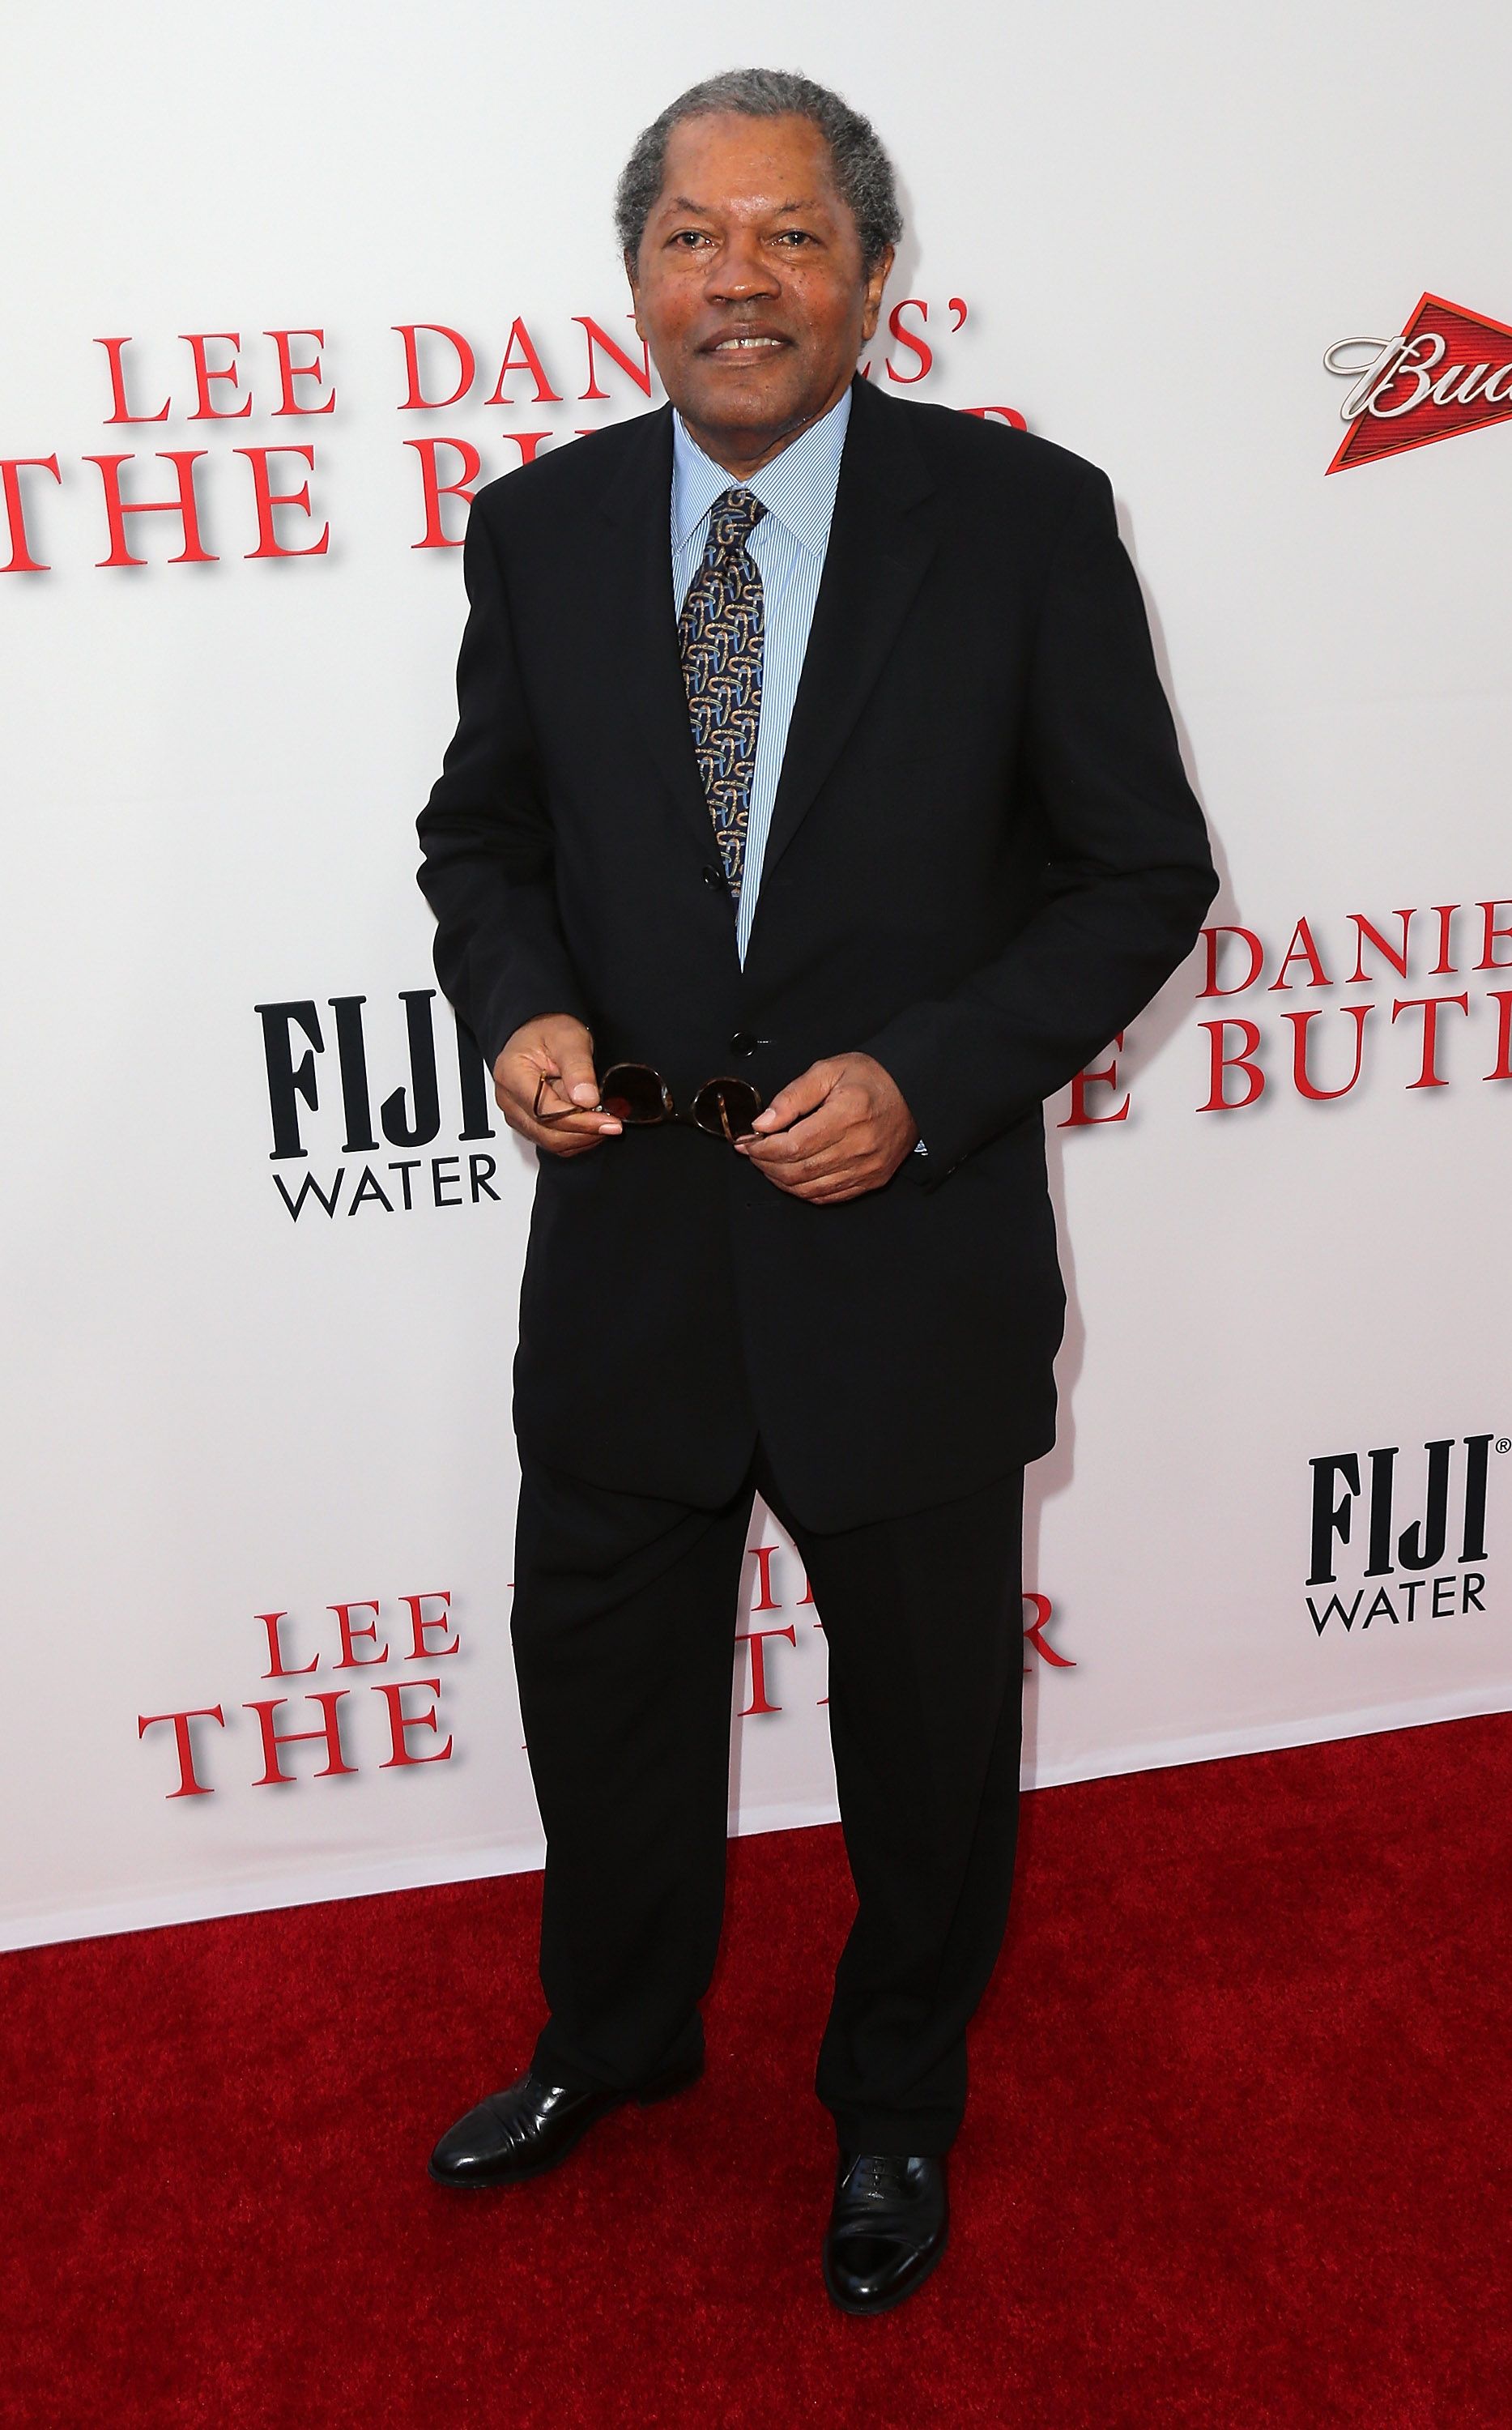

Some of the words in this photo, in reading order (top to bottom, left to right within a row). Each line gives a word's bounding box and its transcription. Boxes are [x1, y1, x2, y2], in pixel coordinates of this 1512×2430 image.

[92, 330, 337, 424] LEE
[391, 297, 969, 411] DANS'
[0, 445, 330, 573] THE
[272, 1153, 502, 1222] WATER
[253, 1591, 460, 1678] LEE
[1305, 1572, 1486, 1637] WATER
[138, 1678, 454, 1799] THE
